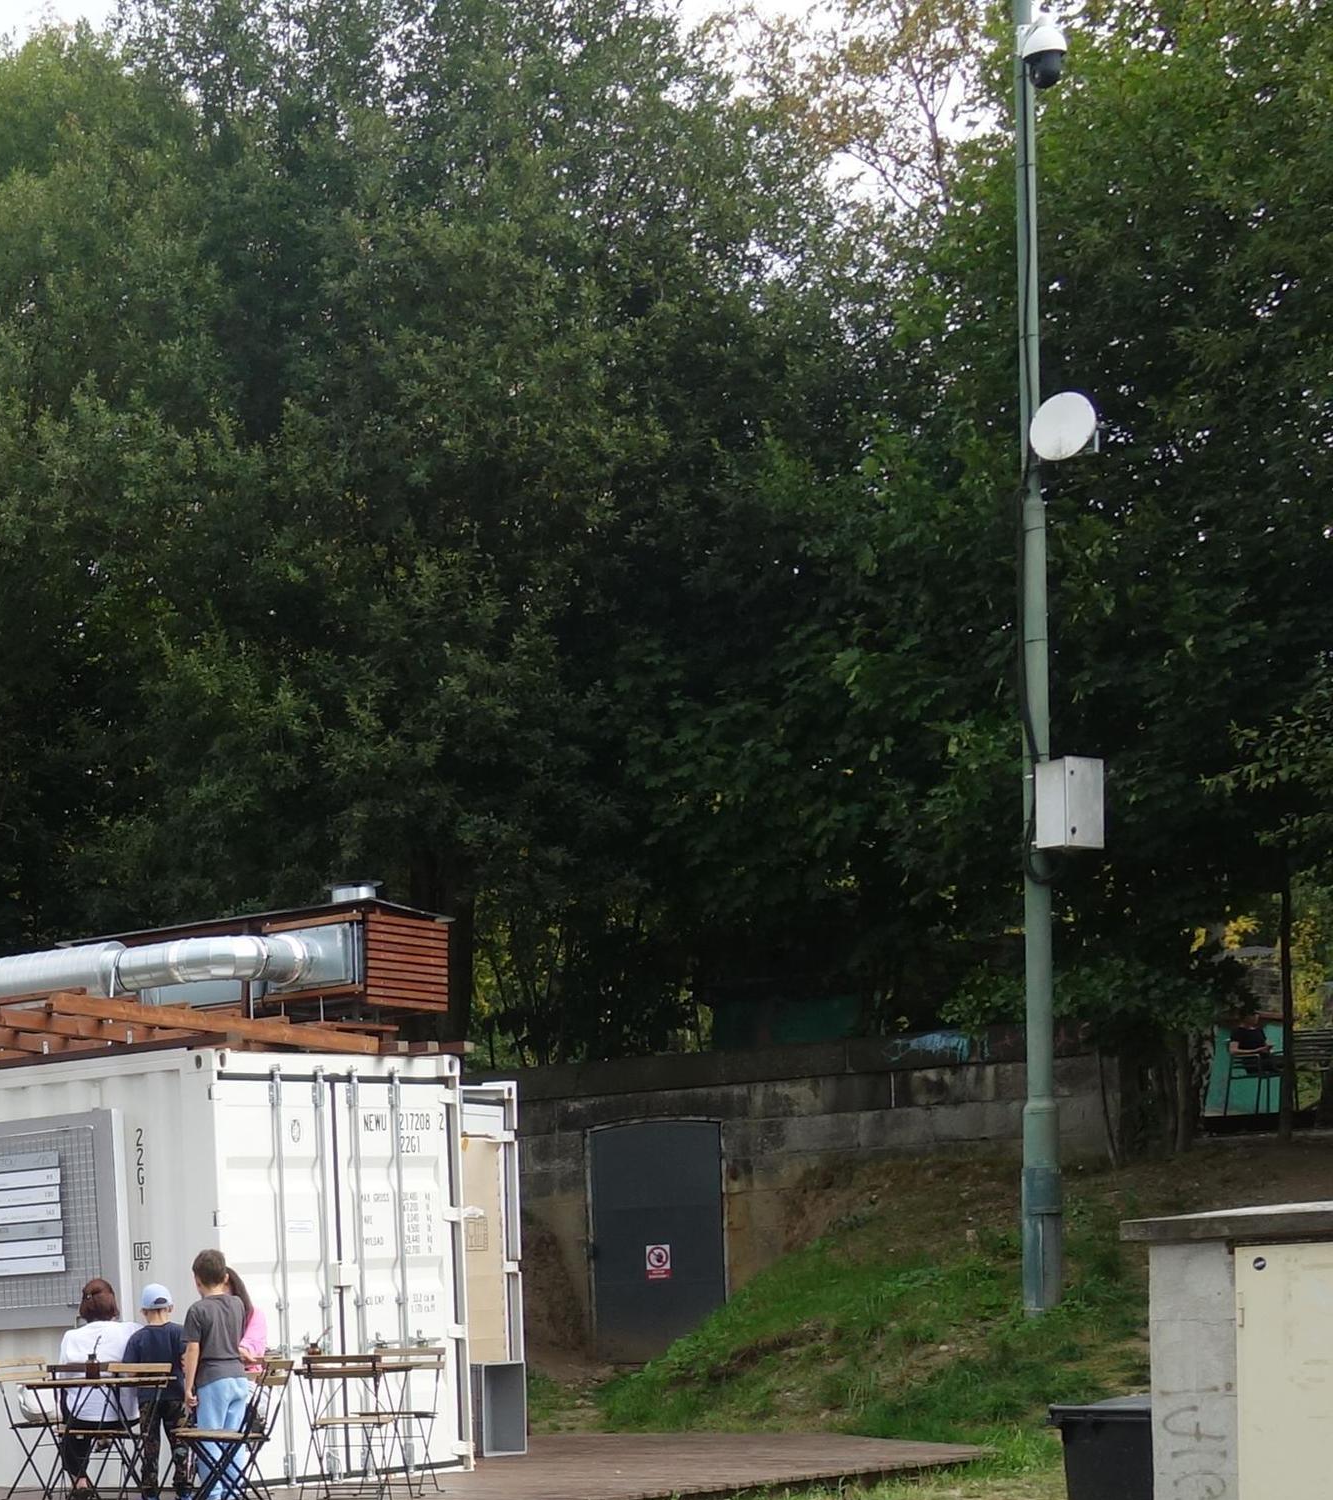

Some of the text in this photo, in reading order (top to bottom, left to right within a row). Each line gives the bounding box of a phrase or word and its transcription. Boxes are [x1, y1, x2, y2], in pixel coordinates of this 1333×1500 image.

[363, 1112, 444, 1131] NEWU 217208 2
[400, 1135, 420, 1153] 22G1
[136, 1128, 144, 1205] 22G1
[138, 1261, 150, 1271] 87
